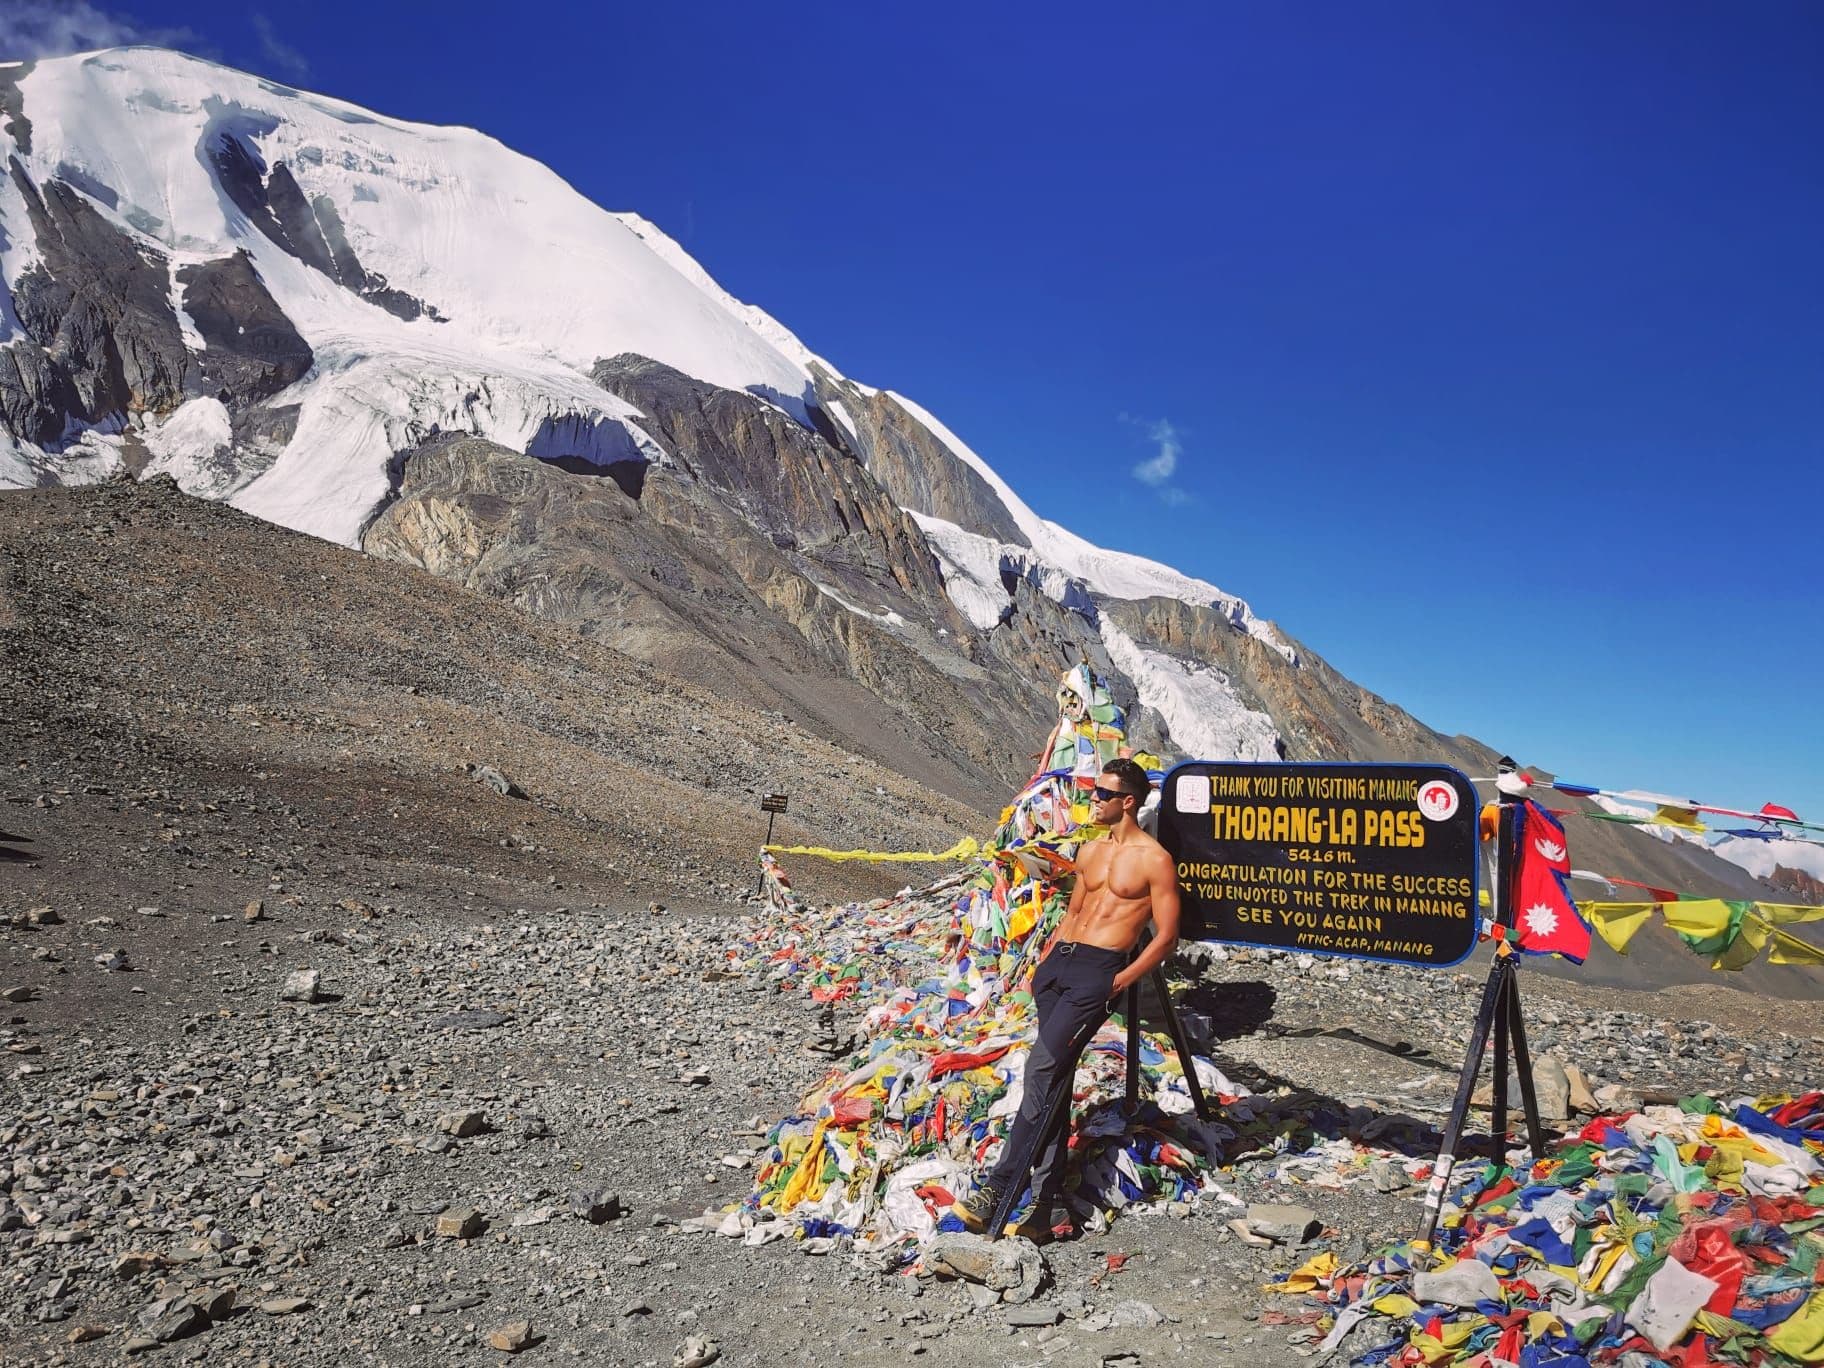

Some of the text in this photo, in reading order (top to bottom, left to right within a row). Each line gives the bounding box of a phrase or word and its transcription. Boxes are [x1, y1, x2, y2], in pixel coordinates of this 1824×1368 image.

[1209, 775, 1418, 802] THANK YOU FOR VISITING MANANG
[1210, 804, 1425, 848] THORANG-LA PASS
[1287, 848, 1334, 863] 5416
[1178, 862, 1472, 898] ONGRATULATION FOR THE SUCCESS
[1197, 883, 1223, 900] YOU
[1225, 884, 1289, 905] ENJOYED
[1292, 890, 1324, 908] THE
[1328, 892, 1371, 912] TREK
[1373, 896, 1392, 913] IN
[1395, 897, 1467, 919] MANANG
[1236, 906, 1382, 933] SEE YOU AGAIN
[1373, 940, 1434, 956] MANANG
